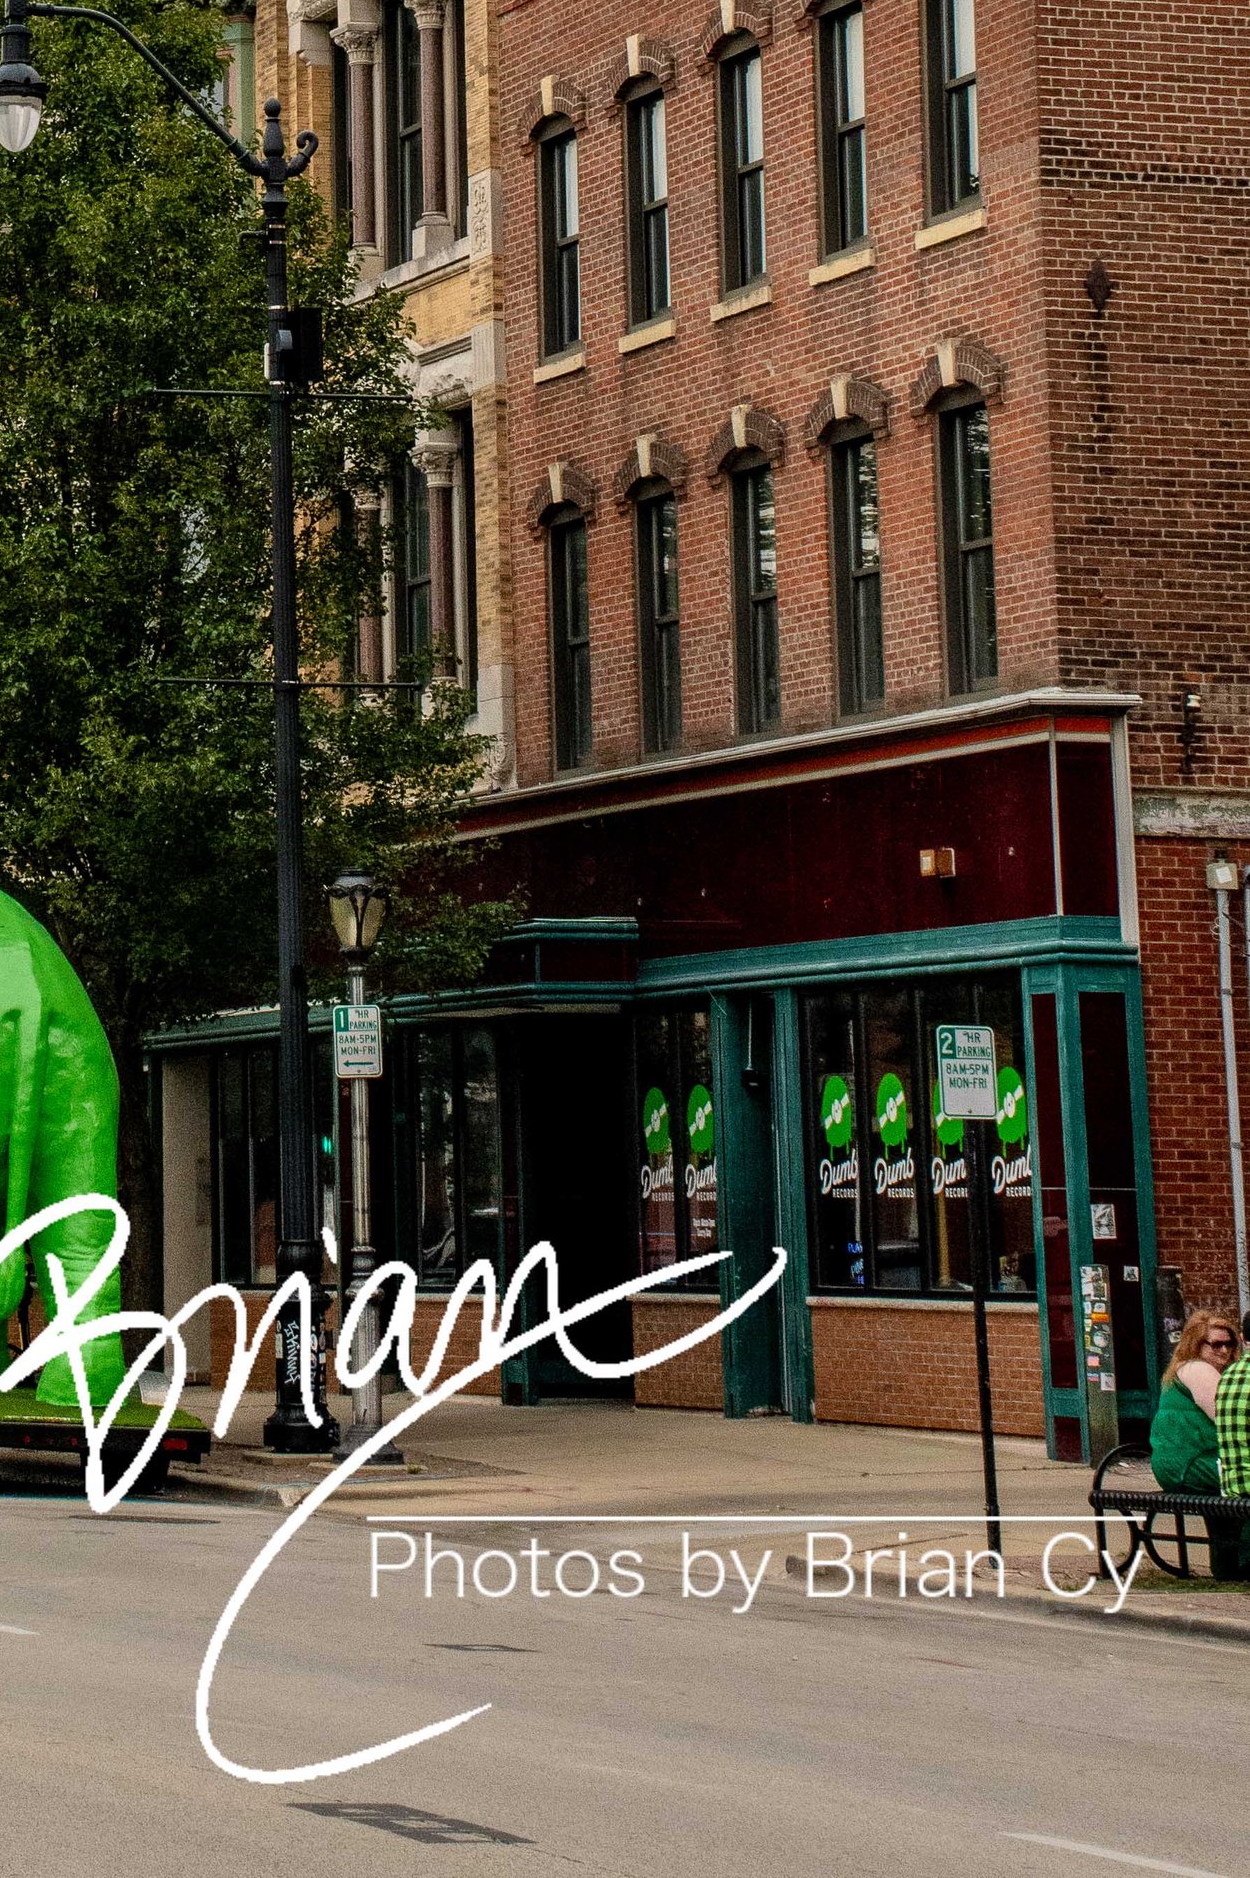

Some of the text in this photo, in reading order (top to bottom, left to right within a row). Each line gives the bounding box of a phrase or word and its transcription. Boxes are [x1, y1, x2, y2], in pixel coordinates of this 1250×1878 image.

[339, 1009, 370, 1029] 1 HR
[350, 1020, 377, 1031] PARKING
[339, 1034, 377, 1044] 8AM-5PM
[940, 1031, 981, 1055] 2 HR
[340, 1045, 376, 1056] MON-FRI
[957, 1045, 991, 1057] PARKING
[946, 1063, 989, 1076] 8AM-5PM
[949, 1077, 988, 1089] MON-FRI
[820, 1148, 858, 1195] Dumb
[874, 1147, 914, 1194] Dumb
[931, 1157, 967, 1194] Dum
[832, 1188, 858, 1198] RECORDS
[888, 1188, 915, 1198] RECORDS
[1005, 1186, 1032, 1197] RECORD
